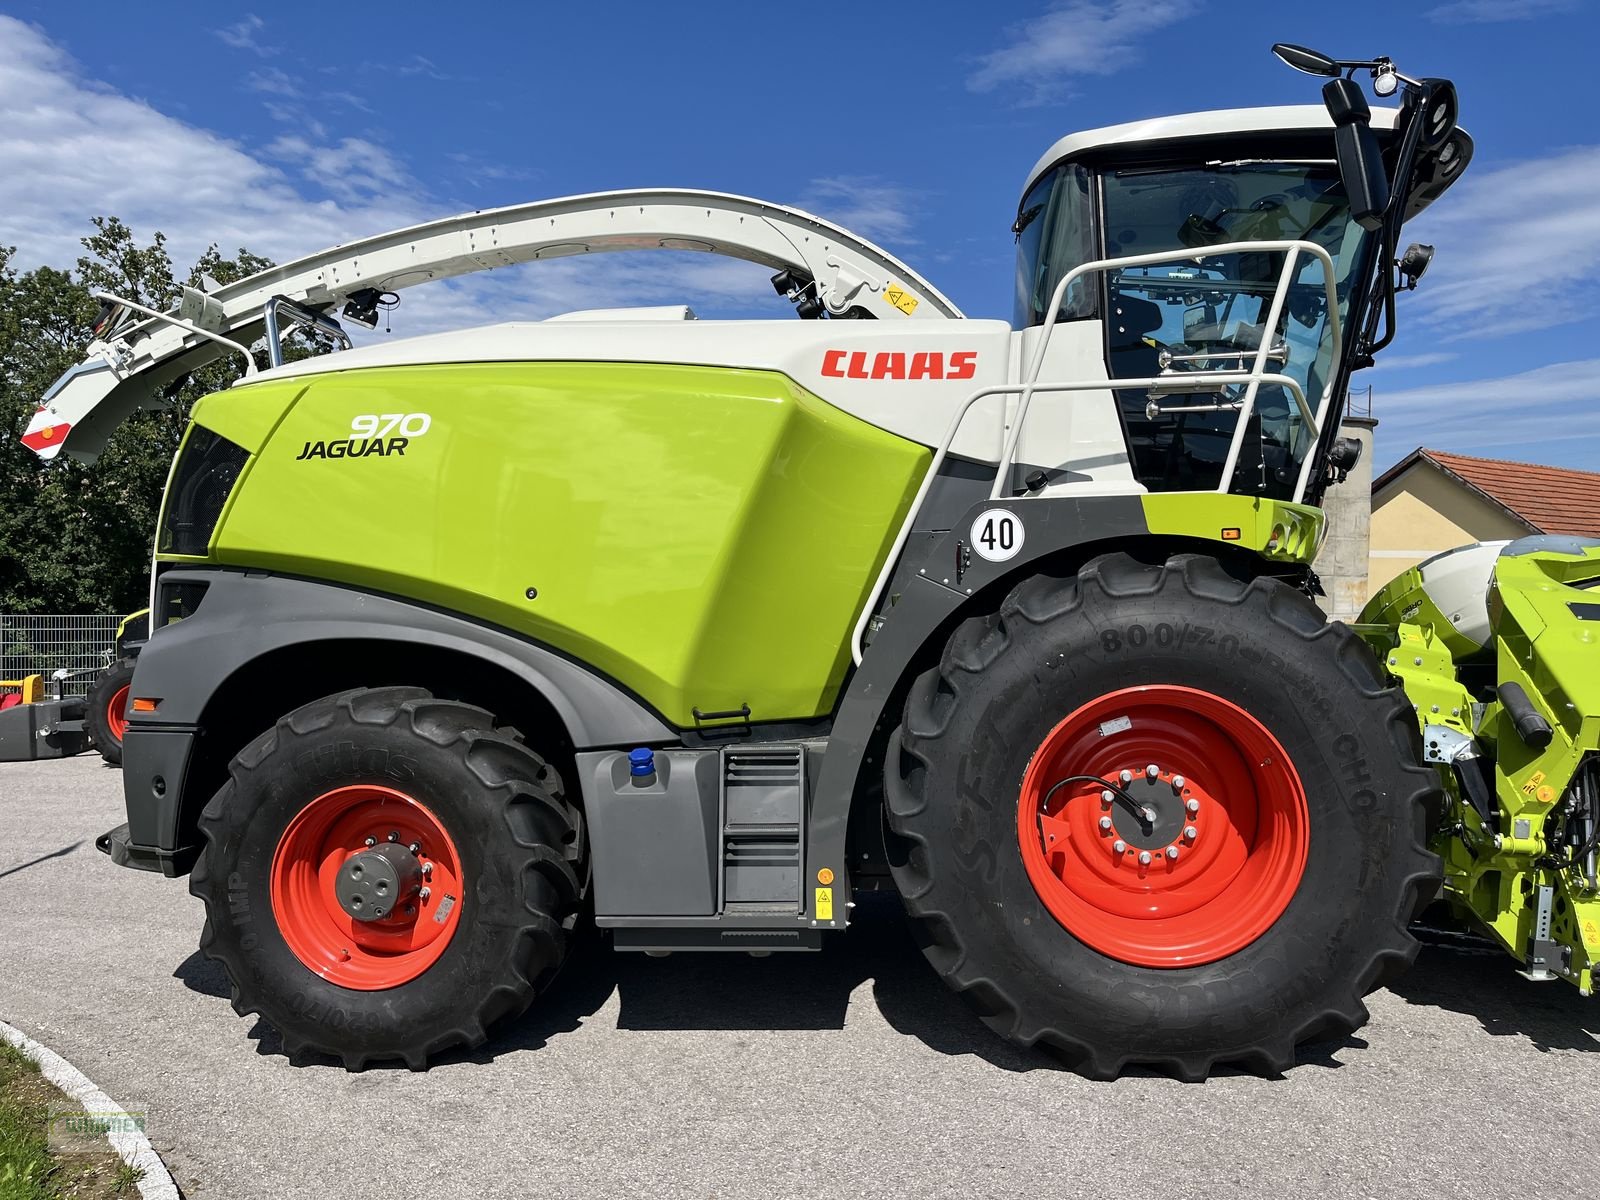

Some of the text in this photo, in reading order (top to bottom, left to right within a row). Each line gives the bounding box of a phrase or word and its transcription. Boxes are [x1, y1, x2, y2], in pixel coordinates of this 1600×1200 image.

[821, 350, 977, 380] CLAAS
[349, 413, 432, 440] 970
[296, 437, 409, 460] JAGUAR
[980, 518, 1014, 550] 40
